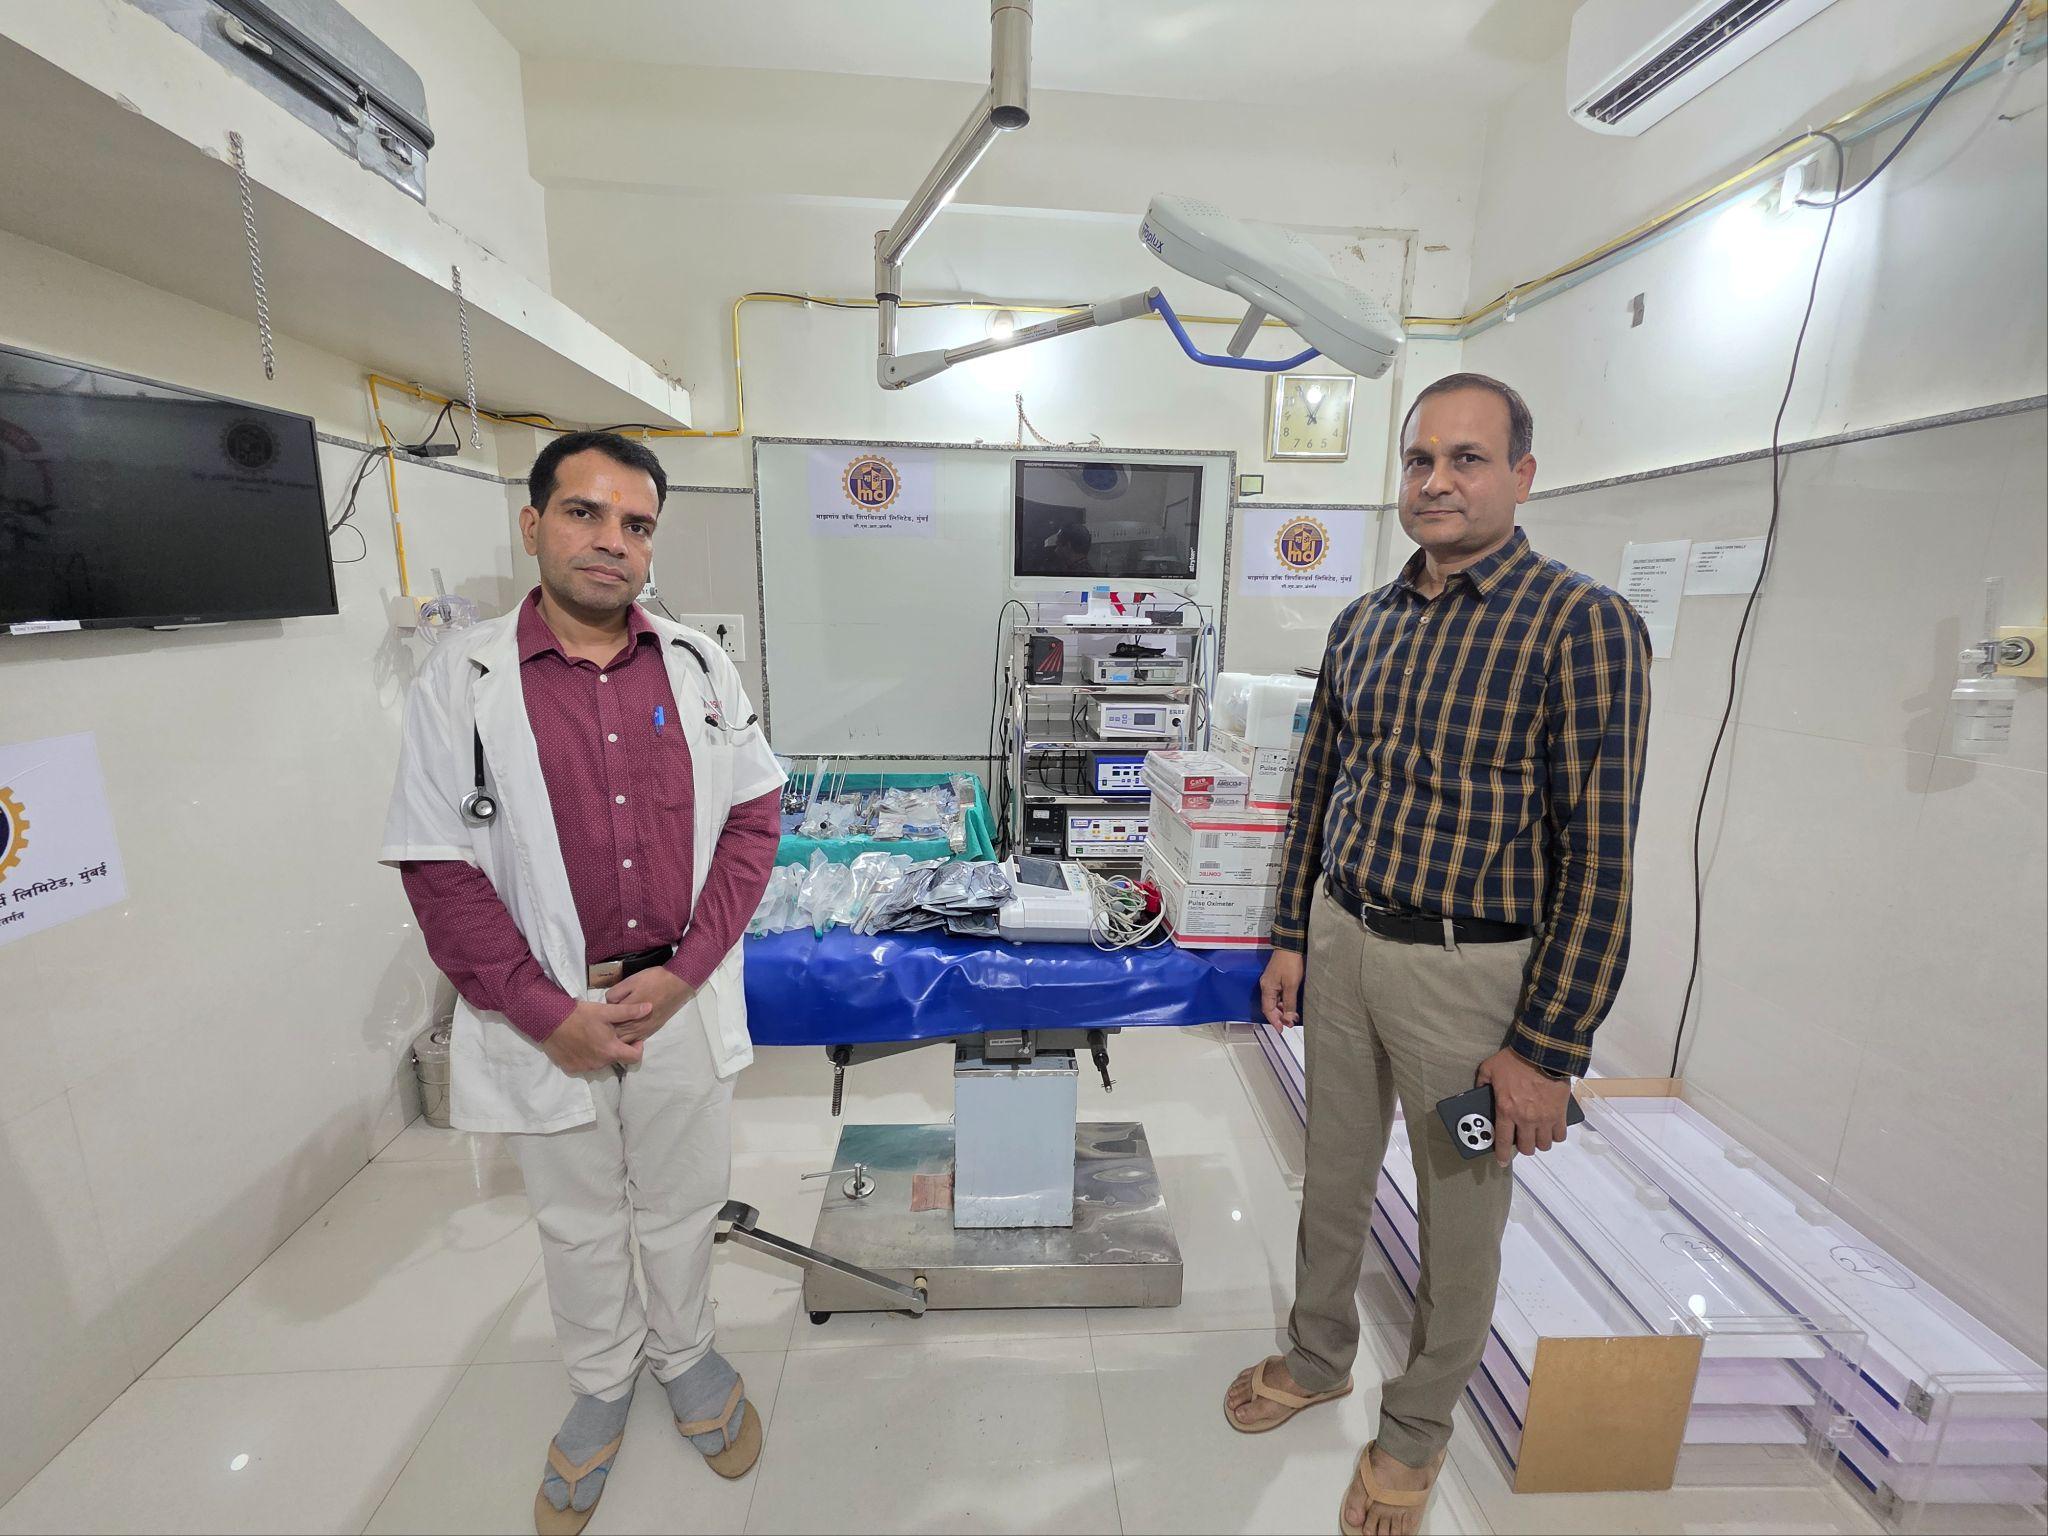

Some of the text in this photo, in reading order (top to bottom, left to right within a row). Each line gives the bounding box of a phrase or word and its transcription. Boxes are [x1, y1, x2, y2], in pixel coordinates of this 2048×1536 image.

[1283, 427, 1290, 437] 8
[1293, 438, 1300, 448] 7
[1306, 438, 1313, 448] 6
[12, 878, 74, 902] लिमिटेड,
[78, 861, 107, 885] मुंबई
